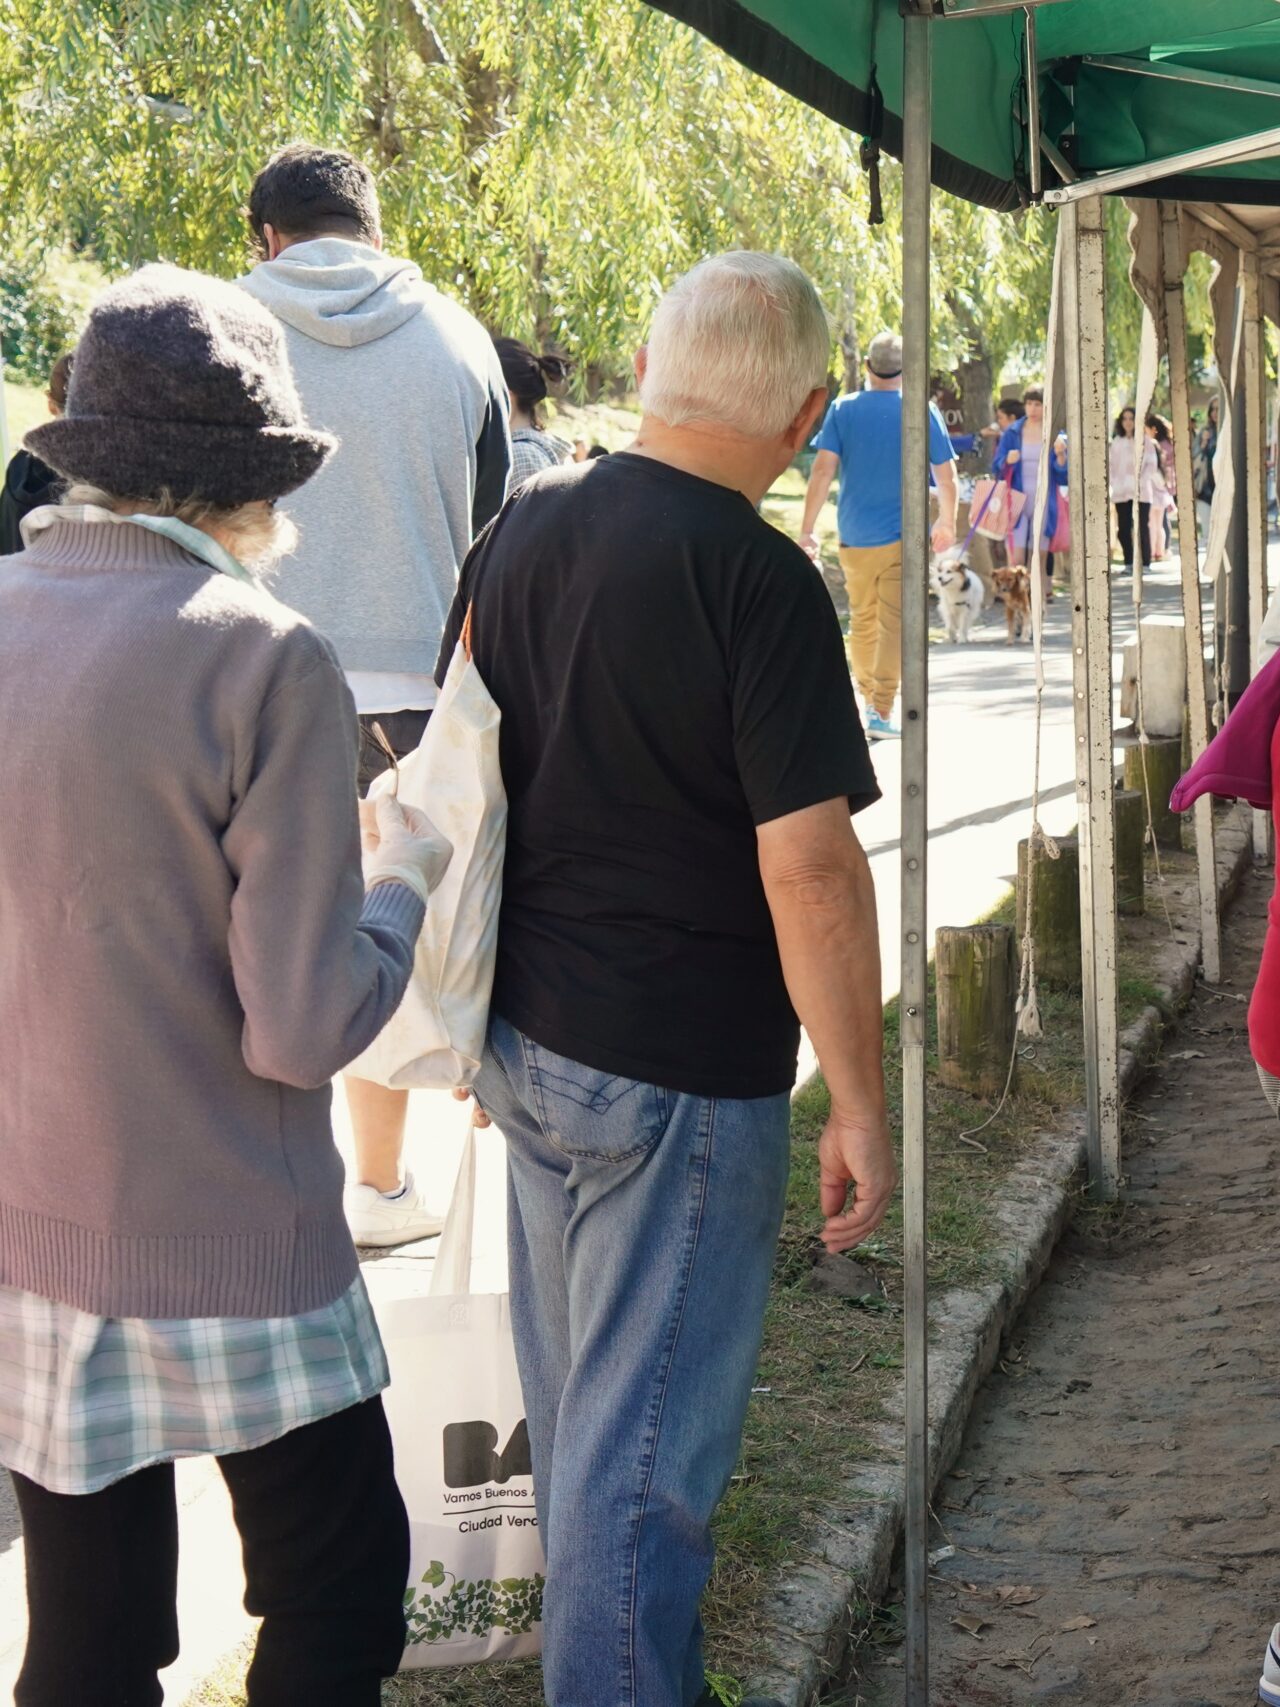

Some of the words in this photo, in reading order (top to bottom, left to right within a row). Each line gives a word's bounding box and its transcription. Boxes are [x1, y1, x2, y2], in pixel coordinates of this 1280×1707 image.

[443, 1491, 482, 1504] Vamos
[485, 1488, 528, 1499] Buenos
[458, 1514, 503, 1533] Ciudad
